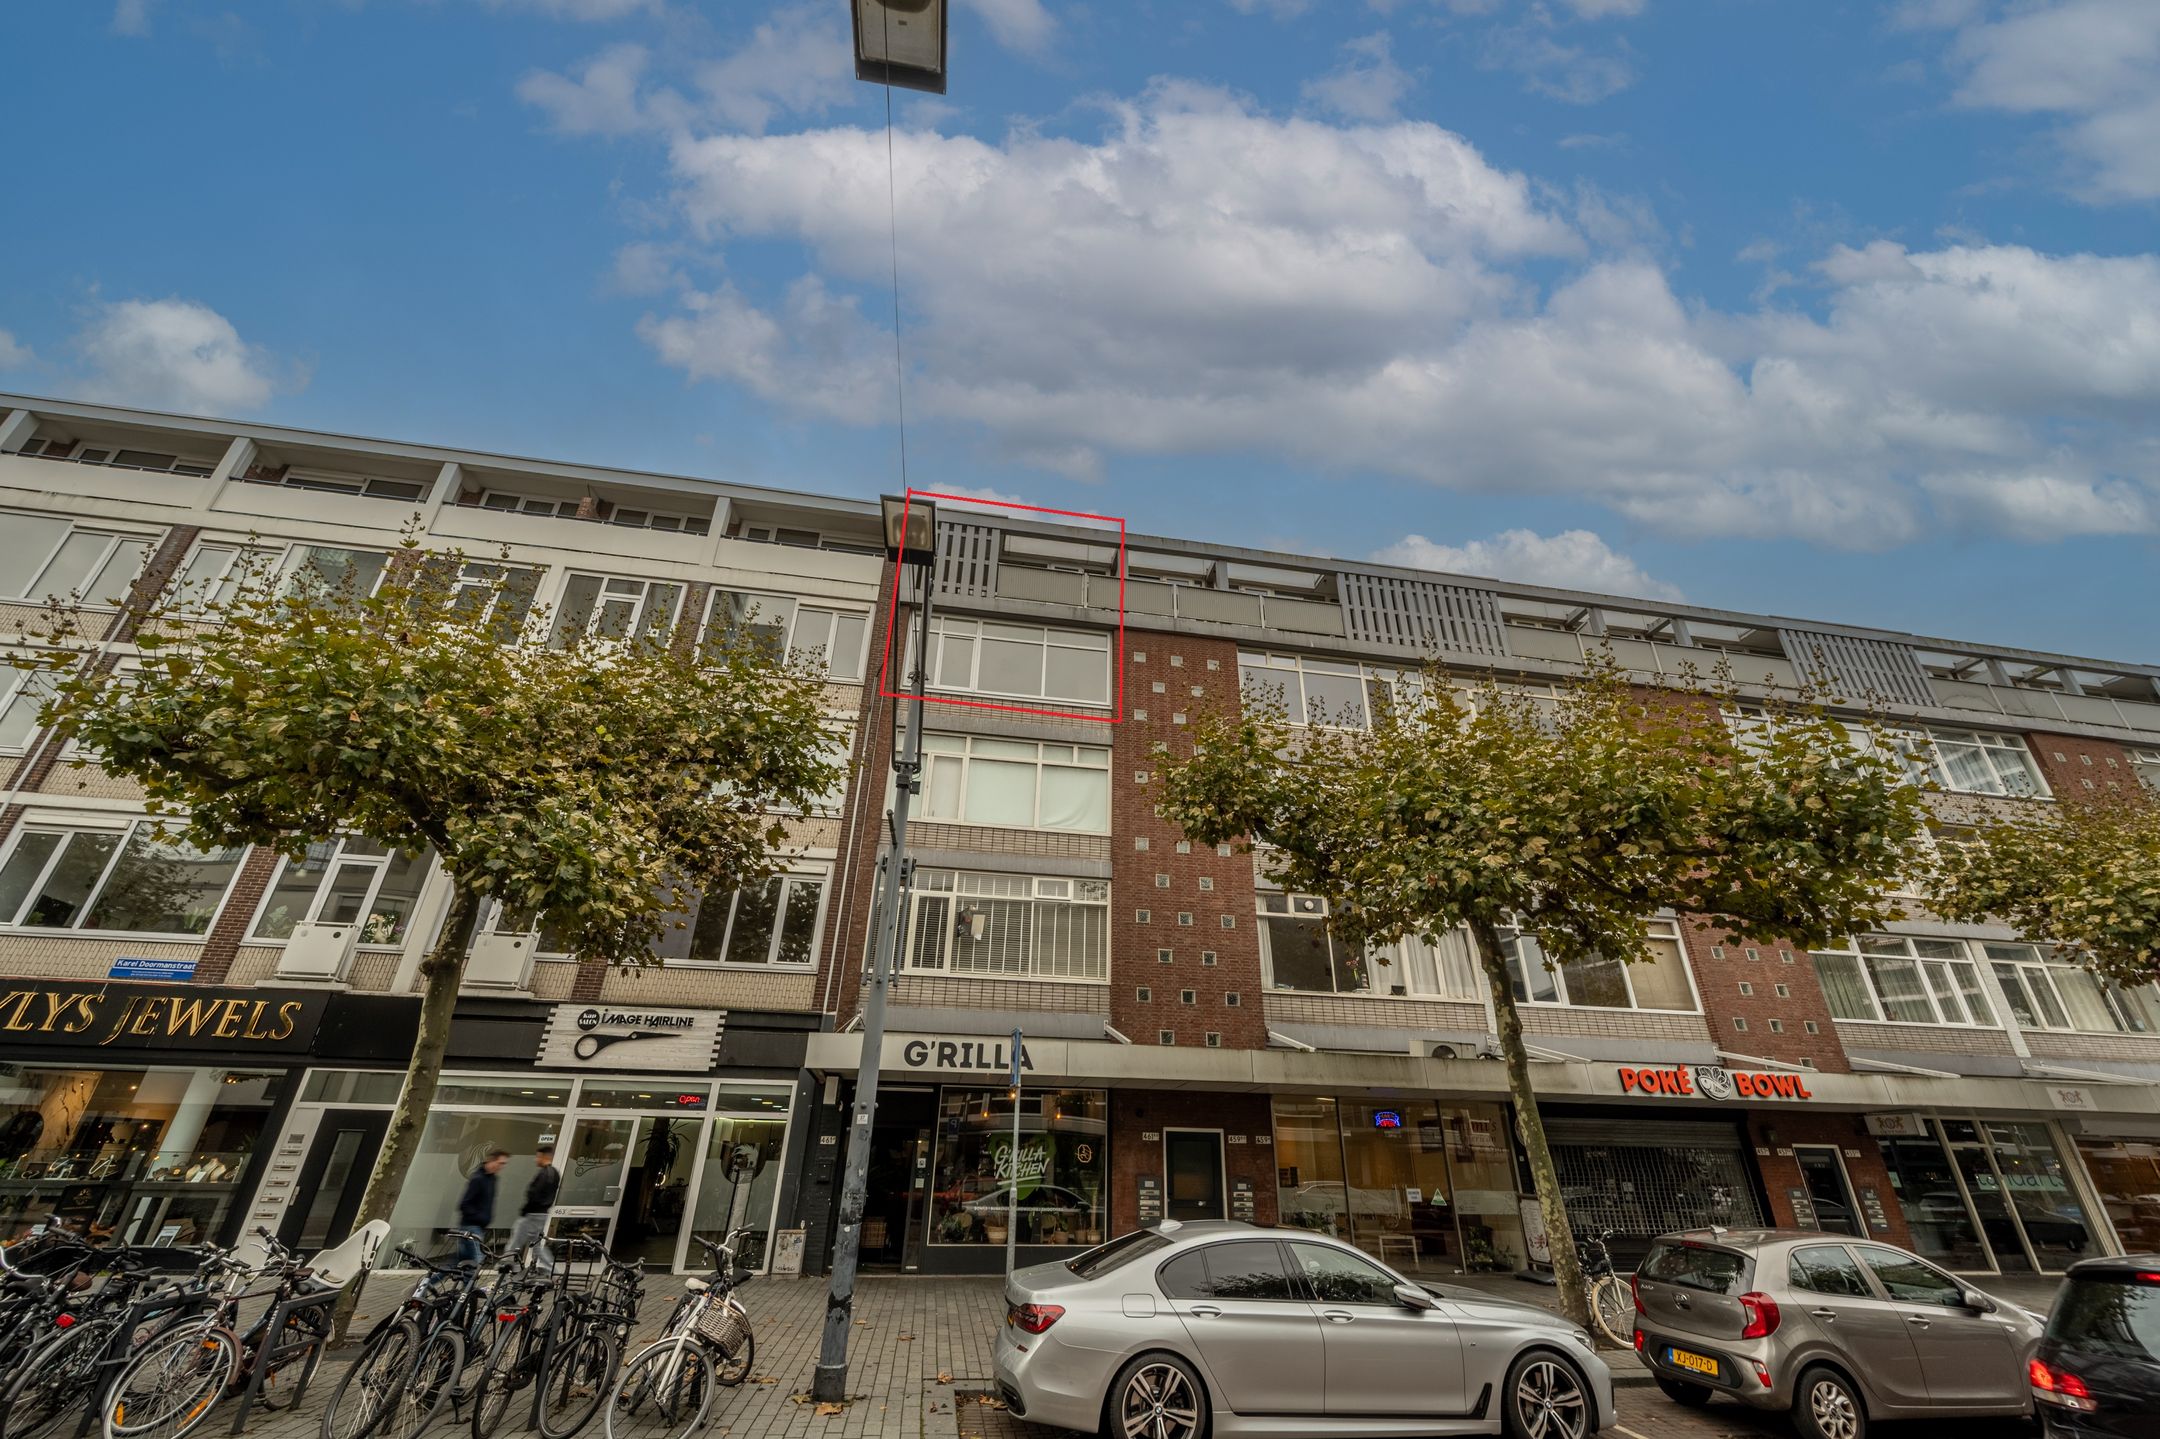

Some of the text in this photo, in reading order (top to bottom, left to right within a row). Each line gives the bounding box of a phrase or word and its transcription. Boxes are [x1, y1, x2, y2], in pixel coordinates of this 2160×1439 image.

[117, 960, 197, 970] Karel Doormanstraat
[99, 996, 303, 1046] JEWELS
[643, 1014, 695, 1028] HAIRLINE
[1618, 1063, 1813, 1099] POKÉ BOWL
[1676, 1351, 1714, 1371] XJ-017-D
